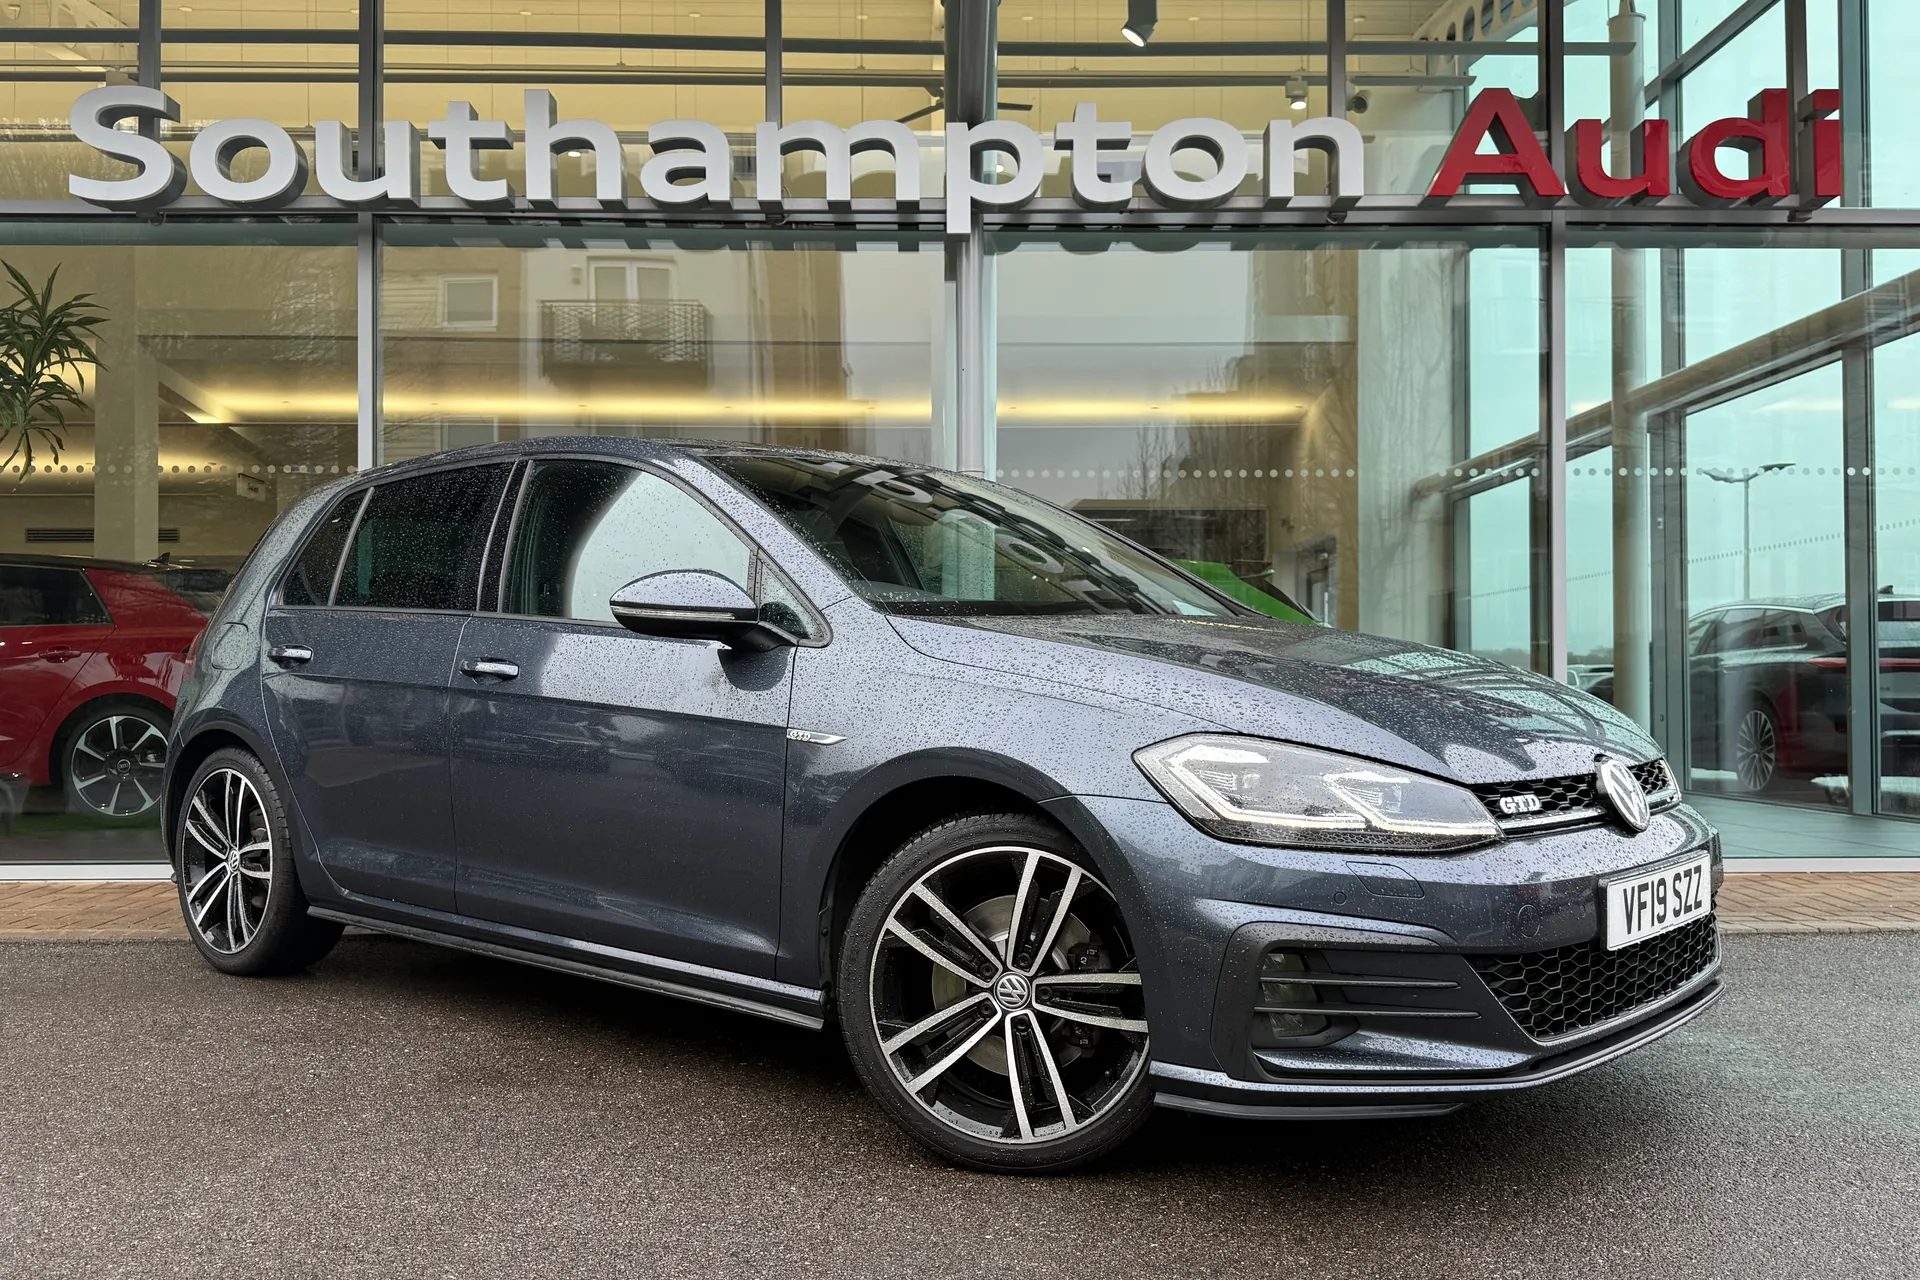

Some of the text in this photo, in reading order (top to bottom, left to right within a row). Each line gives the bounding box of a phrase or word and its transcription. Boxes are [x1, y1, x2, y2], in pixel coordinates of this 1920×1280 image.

[69, 85, 1842, 235] Southampton Audi
[1499, 793, 1541, 815] GTD
[1623, 864, 1703, 935] VF19 SZZ
